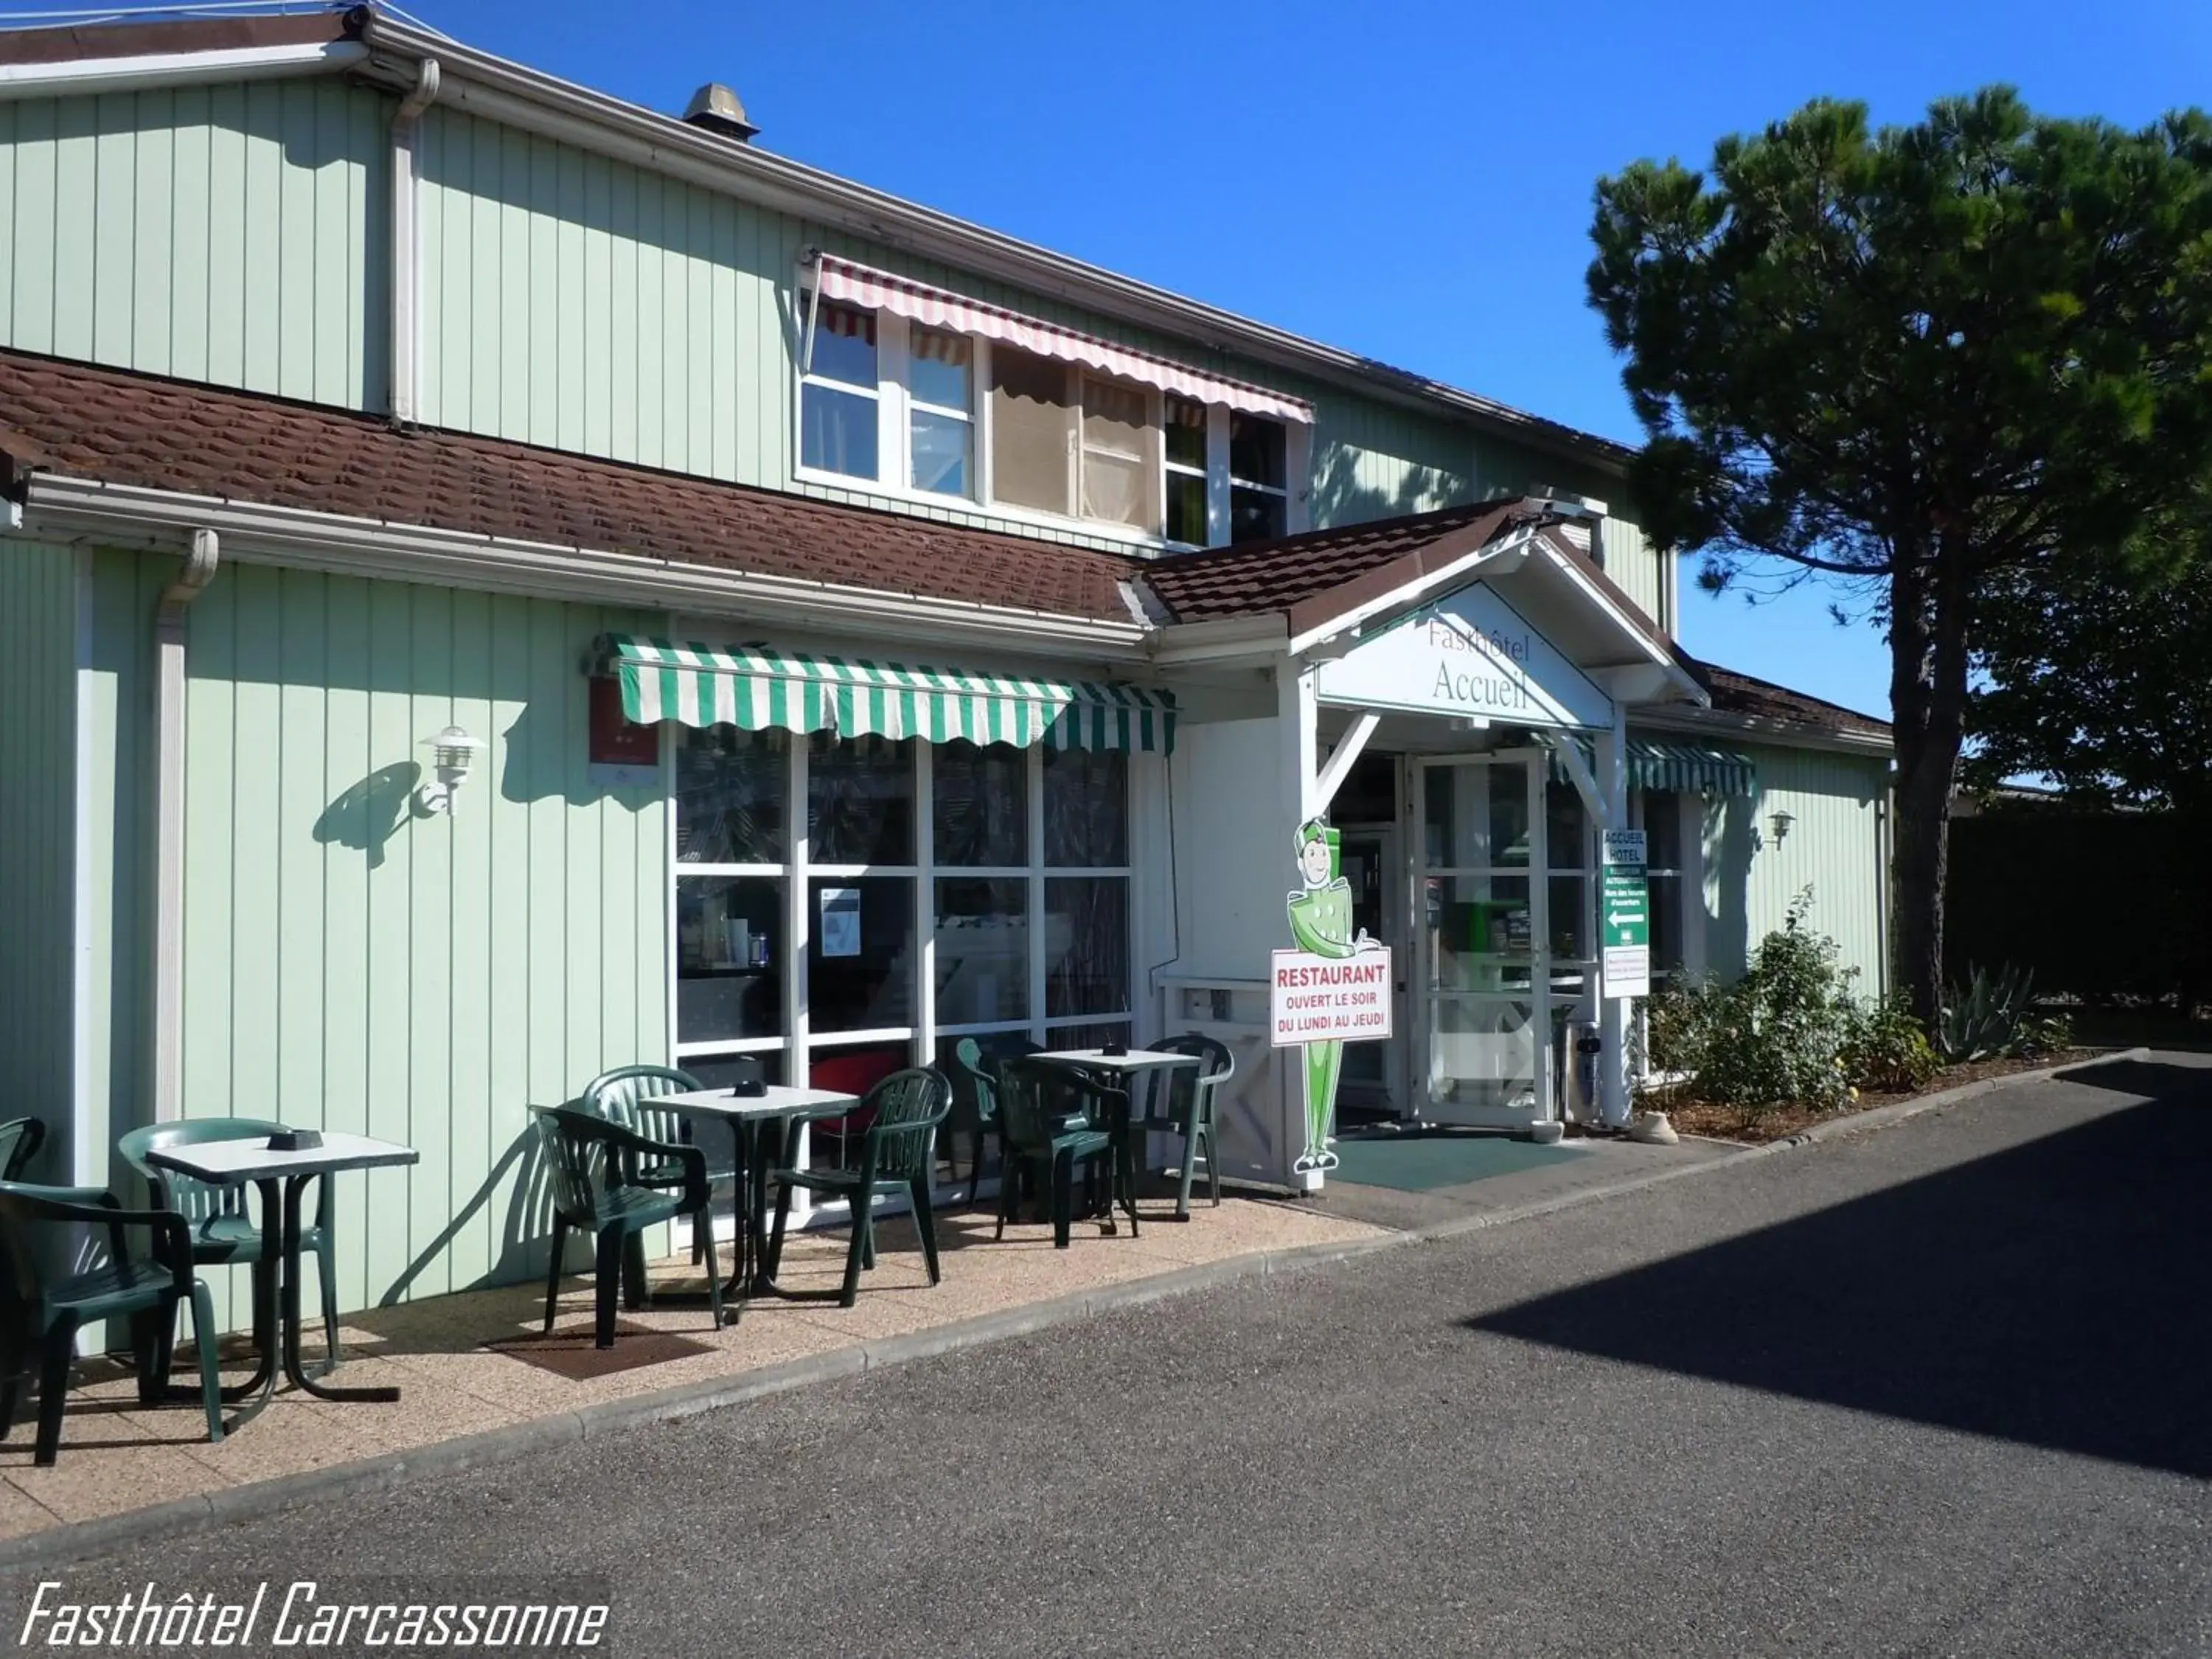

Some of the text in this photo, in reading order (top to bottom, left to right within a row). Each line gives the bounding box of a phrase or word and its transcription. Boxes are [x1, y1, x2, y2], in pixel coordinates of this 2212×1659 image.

[1429, 622, 1529, 661] Fasthôtel
[1433, 661, 1528, 709] Accueil
[1604, 832, 1644, 844] ACCUEIL
[1277, 965, 1385, 987] RESTAURANT
[1286, 992, 1377, 1009] OUVERT LE SOIR
[1278, 1012, 1384, 1032] DU LUNDI AU JEUDI
